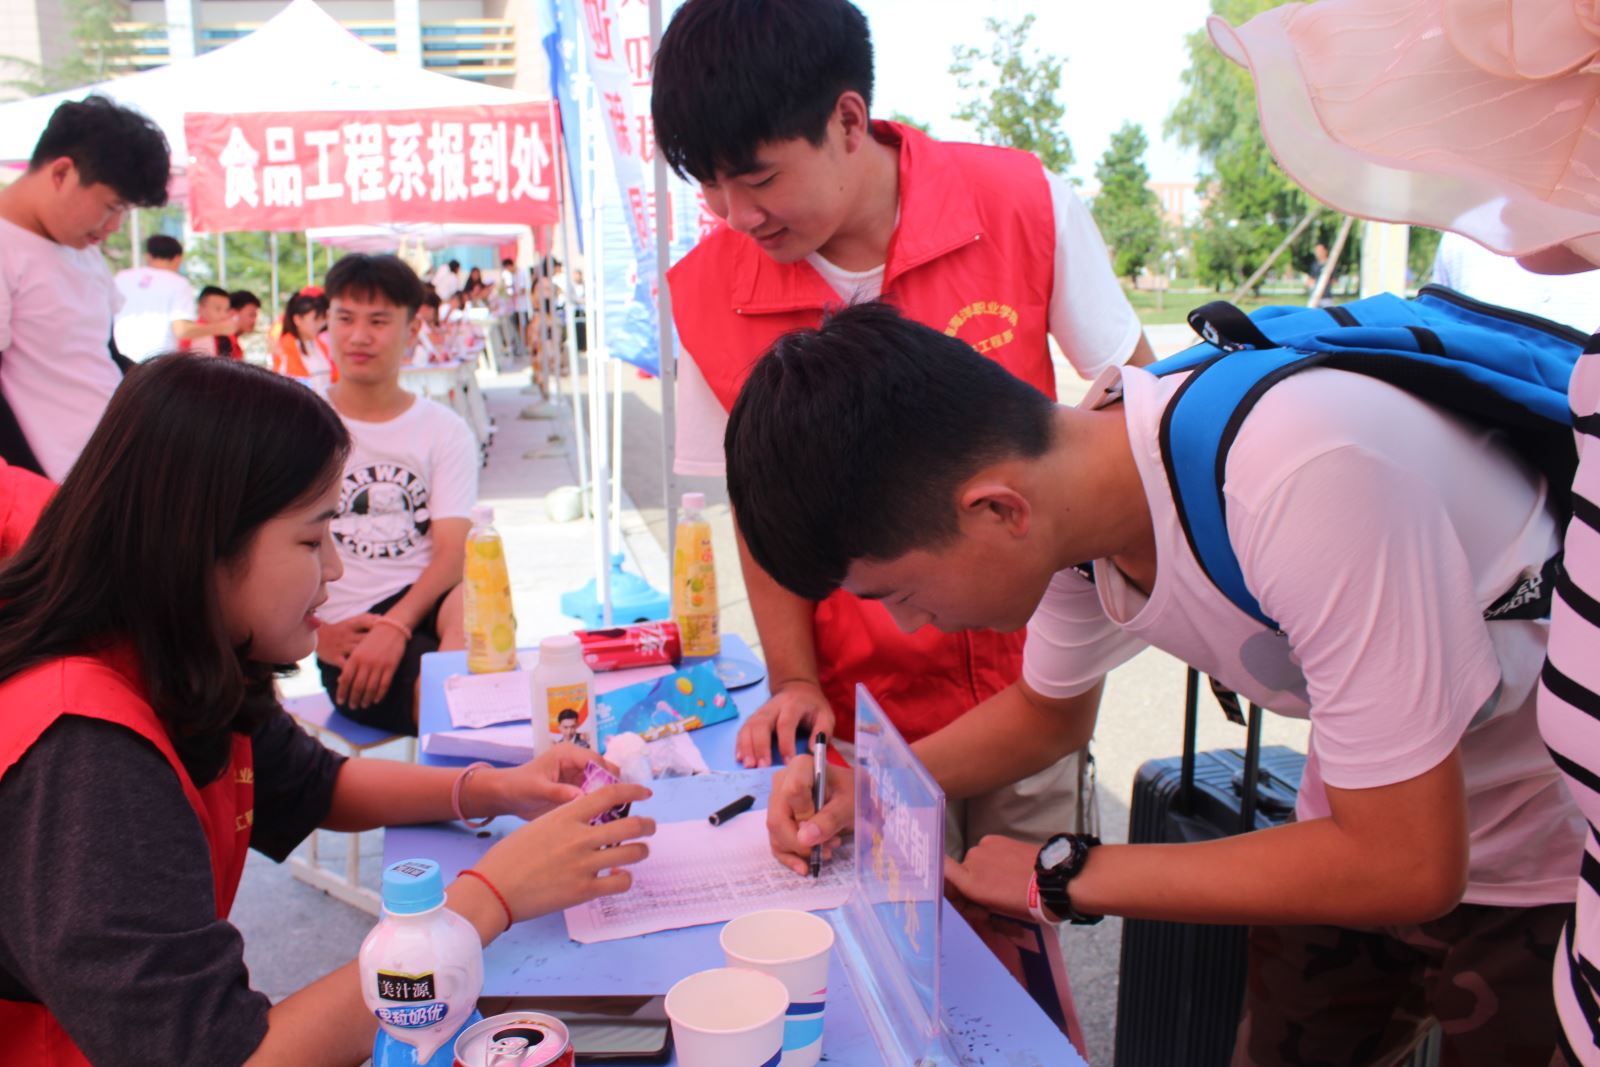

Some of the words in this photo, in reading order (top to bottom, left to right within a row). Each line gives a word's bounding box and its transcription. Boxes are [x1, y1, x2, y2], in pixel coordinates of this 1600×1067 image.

[218, 121, 552, 208] 食品工程系报到处
[379, 980, 430, 999] 美汁源
